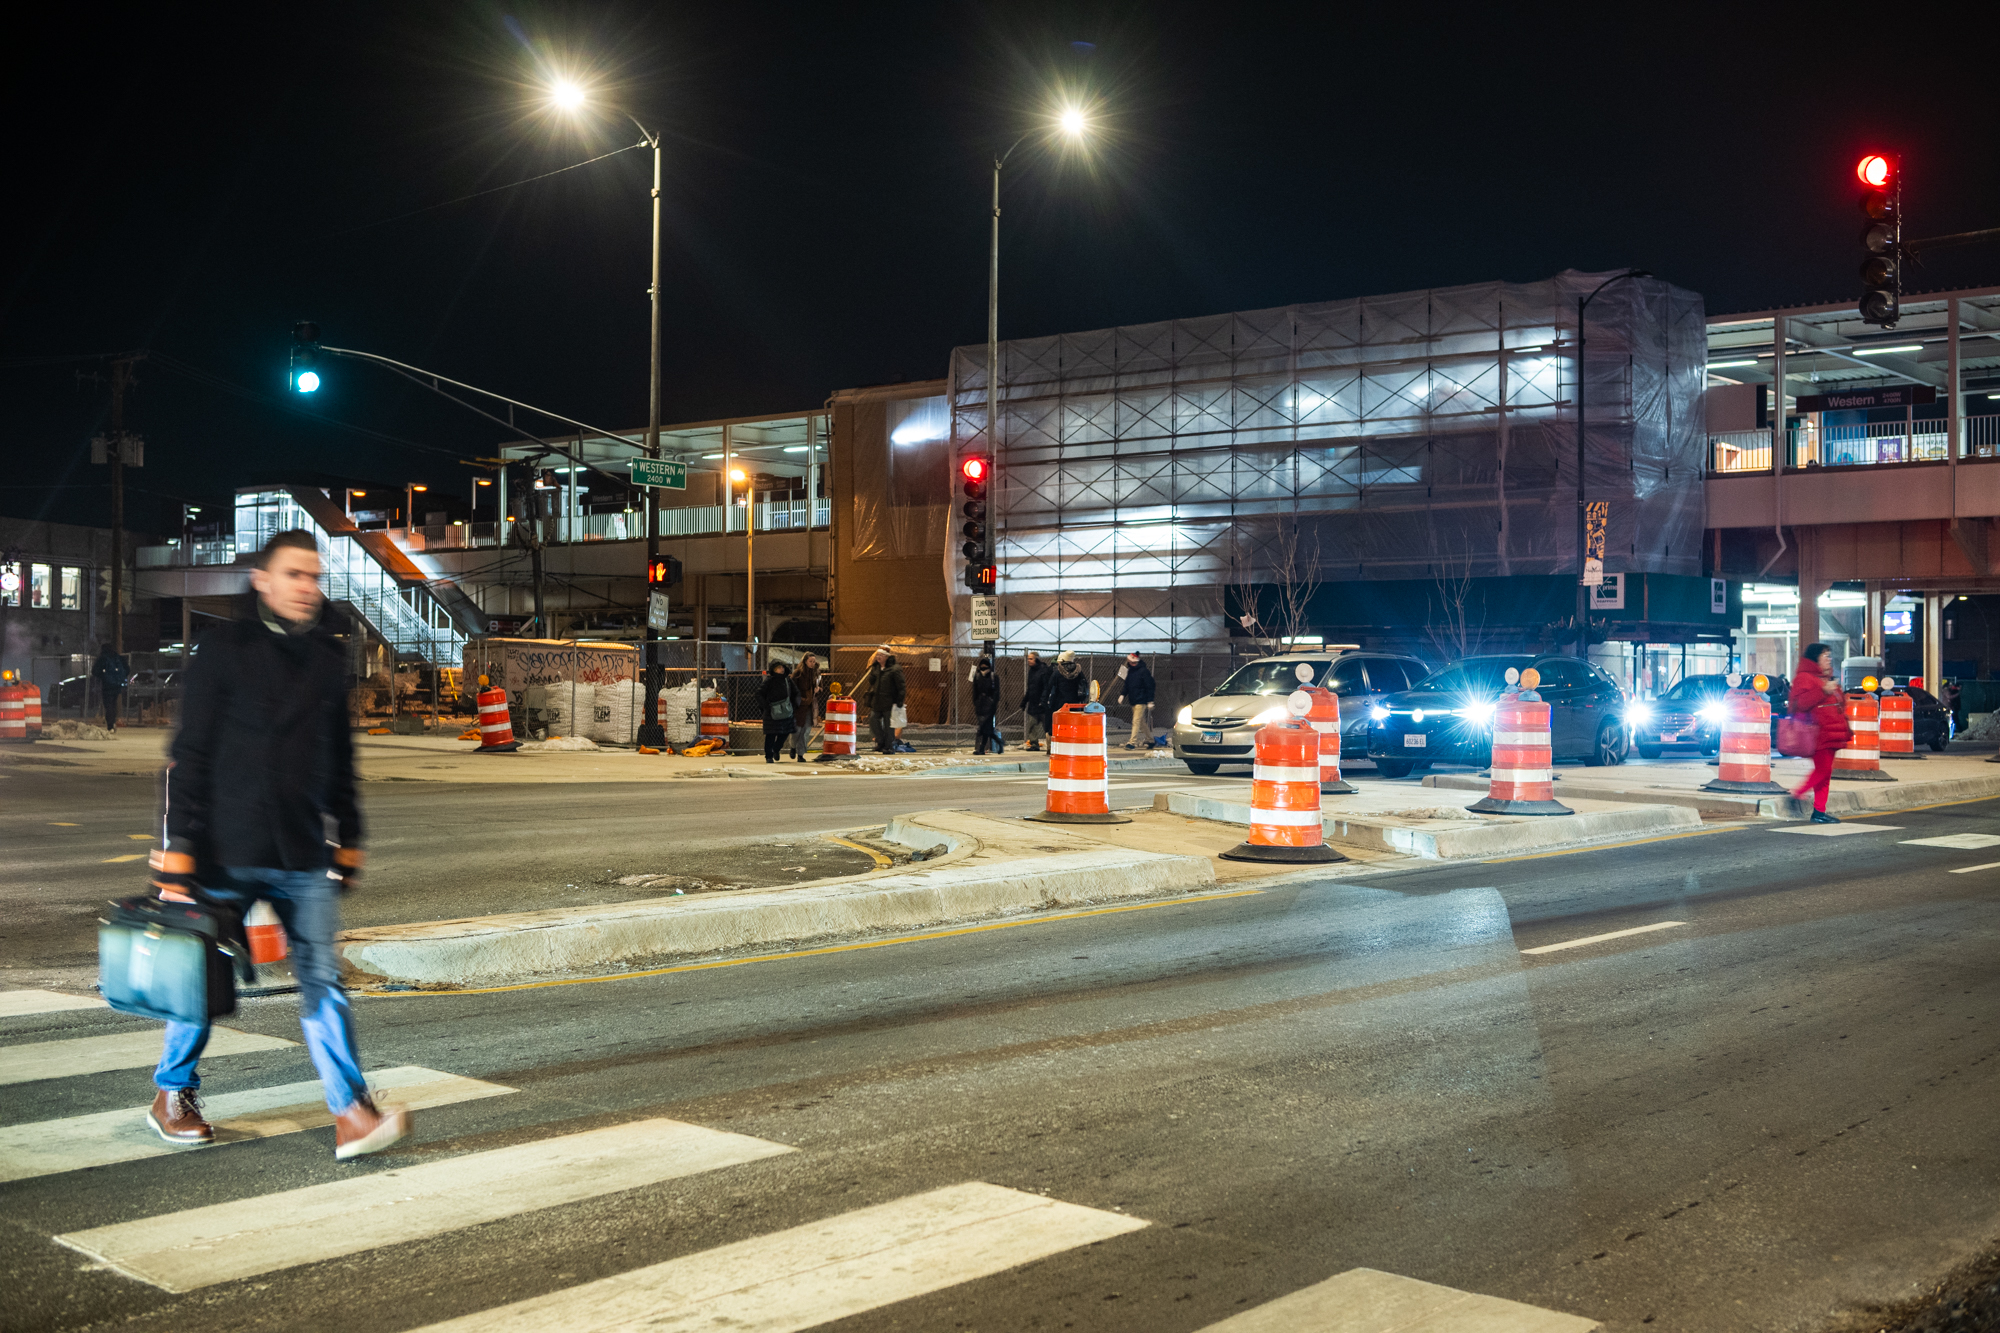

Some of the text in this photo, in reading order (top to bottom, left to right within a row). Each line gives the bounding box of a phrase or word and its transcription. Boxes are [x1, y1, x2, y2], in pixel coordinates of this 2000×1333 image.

[1828, 395, 1875, 408] Western
[633, 461, 685, 476] N WESTERN AV
[647, 474, 672, 485] 2400 W
[655, 597, 664, 606] NO
[975, 600, 996, 608] TURNING
[974, 609, 997, 617] VEHICLES
[990, 618, 997, 626] TO
[972, 627, 998, 636] PEDESTRIANS
